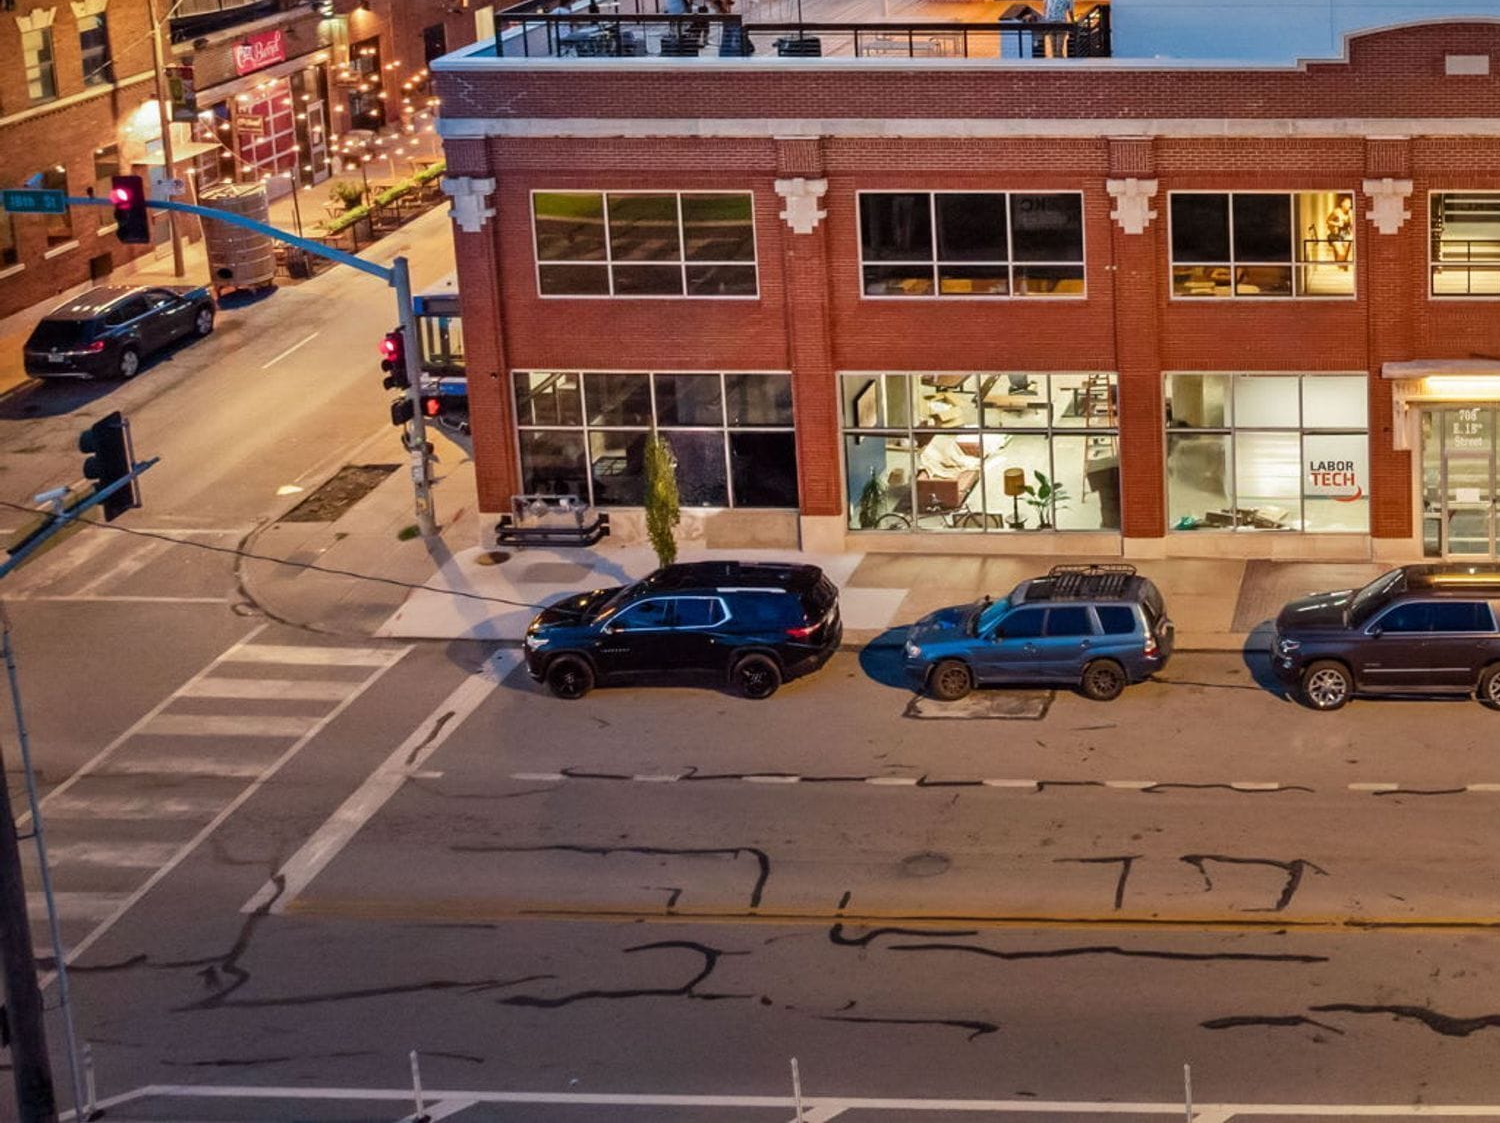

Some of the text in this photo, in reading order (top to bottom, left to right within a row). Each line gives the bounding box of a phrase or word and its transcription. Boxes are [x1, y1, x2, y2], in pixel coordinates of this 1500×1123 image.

[1454, 435, 1482, 447] Street
[1310, 461, 1354, 471] LABOR
[1311, 473, 1355, 486] TECH
